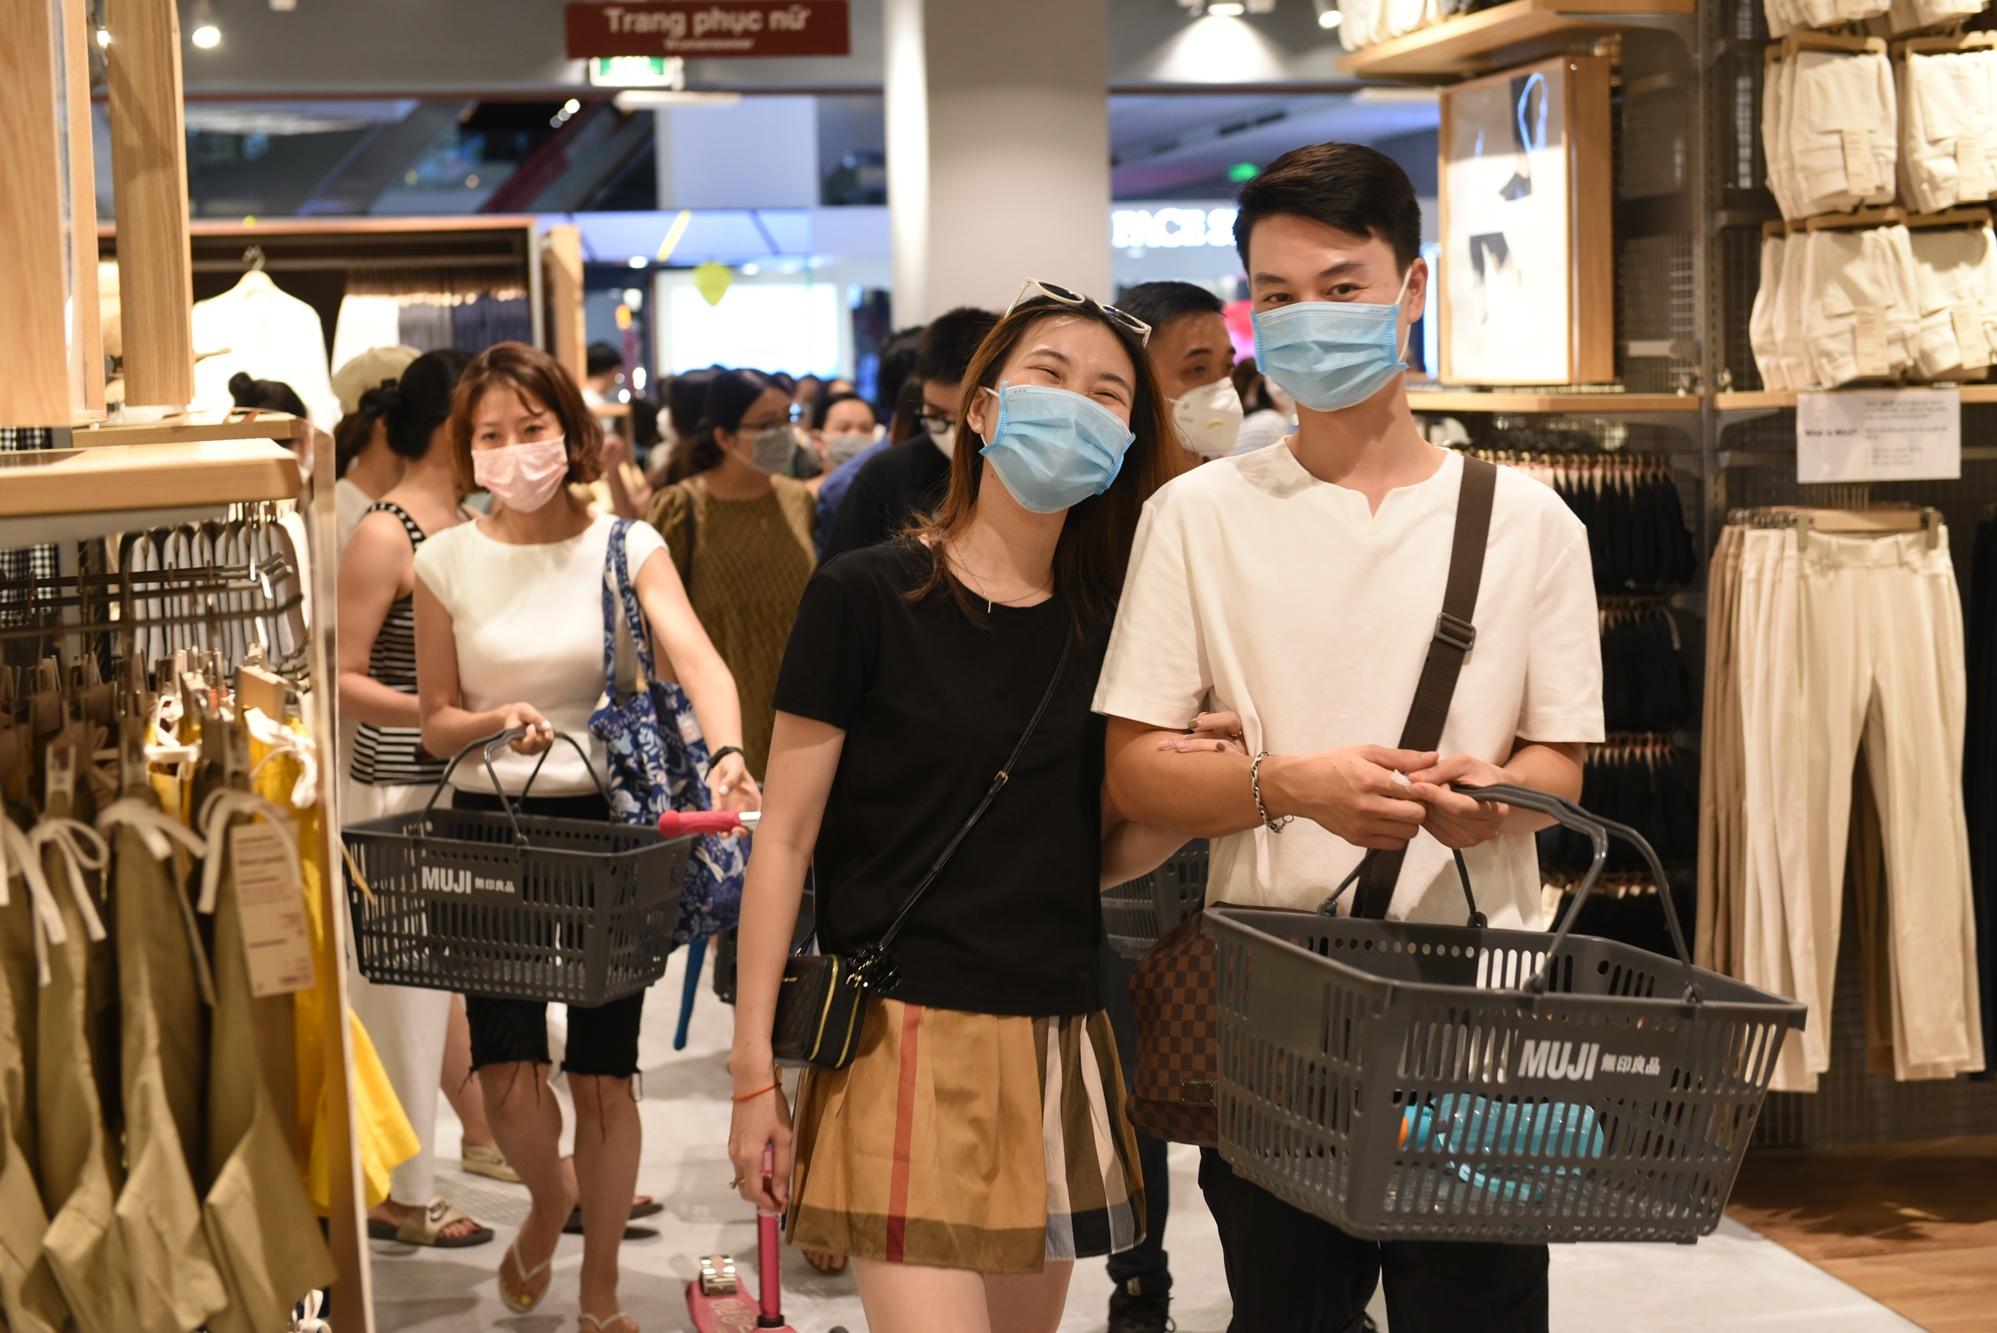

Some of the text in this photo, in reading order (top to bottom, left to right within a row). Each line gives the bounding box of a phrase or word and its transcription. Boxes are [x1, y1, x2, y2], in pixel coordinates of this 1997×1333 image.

[604, 2, 811, 37] Trang phục nữ
[1112, 208, 1205, 248] FACE
[421, 866, 472, 895] MUJI
[1517, 1039, 1661, 1081] MUJI 無印良品
